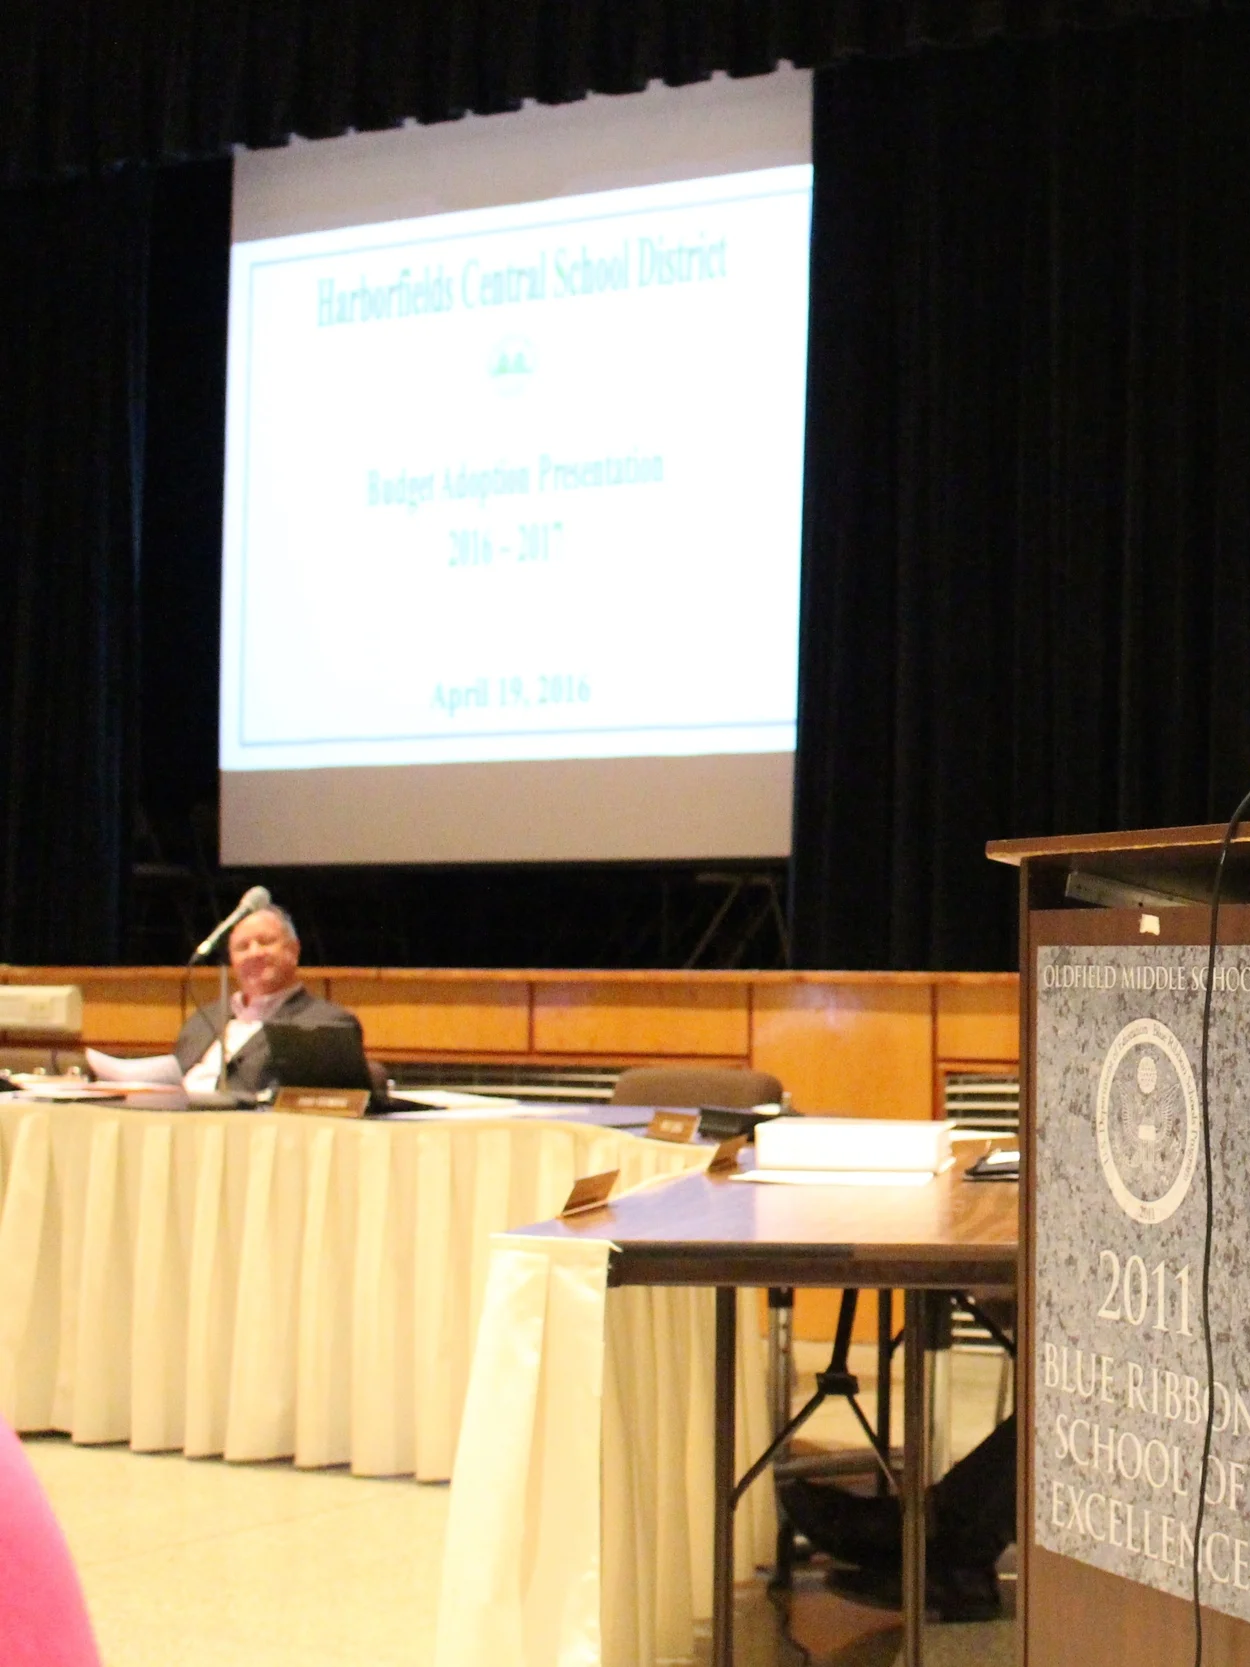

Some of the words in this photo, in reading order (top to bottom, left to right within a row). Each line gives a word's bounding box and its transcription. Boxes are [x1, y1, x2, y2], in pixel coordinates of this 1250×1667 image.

[317, 264, 455, 328] Harborfields
[460, 251, 547, 309] Central
[552, 238, 631, 298] School
[637, 230, 728, 288] District
[366, 467, 434, 514] Budget
[441, 458, 530, 508] Adoption
[538, 445, 665, 493] Presentation
[448, 528, 493, 568] 2016
[516, 519, 564, 563] 2017
[430, 676, 489, 717] April
[536, 673, 591, 705] 2016
[1043, 964, 1117, 990] OLDFIELD
[1121, 966, 1186, 991] MIDDLE
[1097, 1249, 1193, 1337] 2011
[1044, 1341, 1115, 1403] BLUE
[1055, 1413, 1188, 1496] SCHOOL
[1200, 1454, 1246, 1512] OF
[1051, 1480, 1250, 1591] EXCELLENCE
